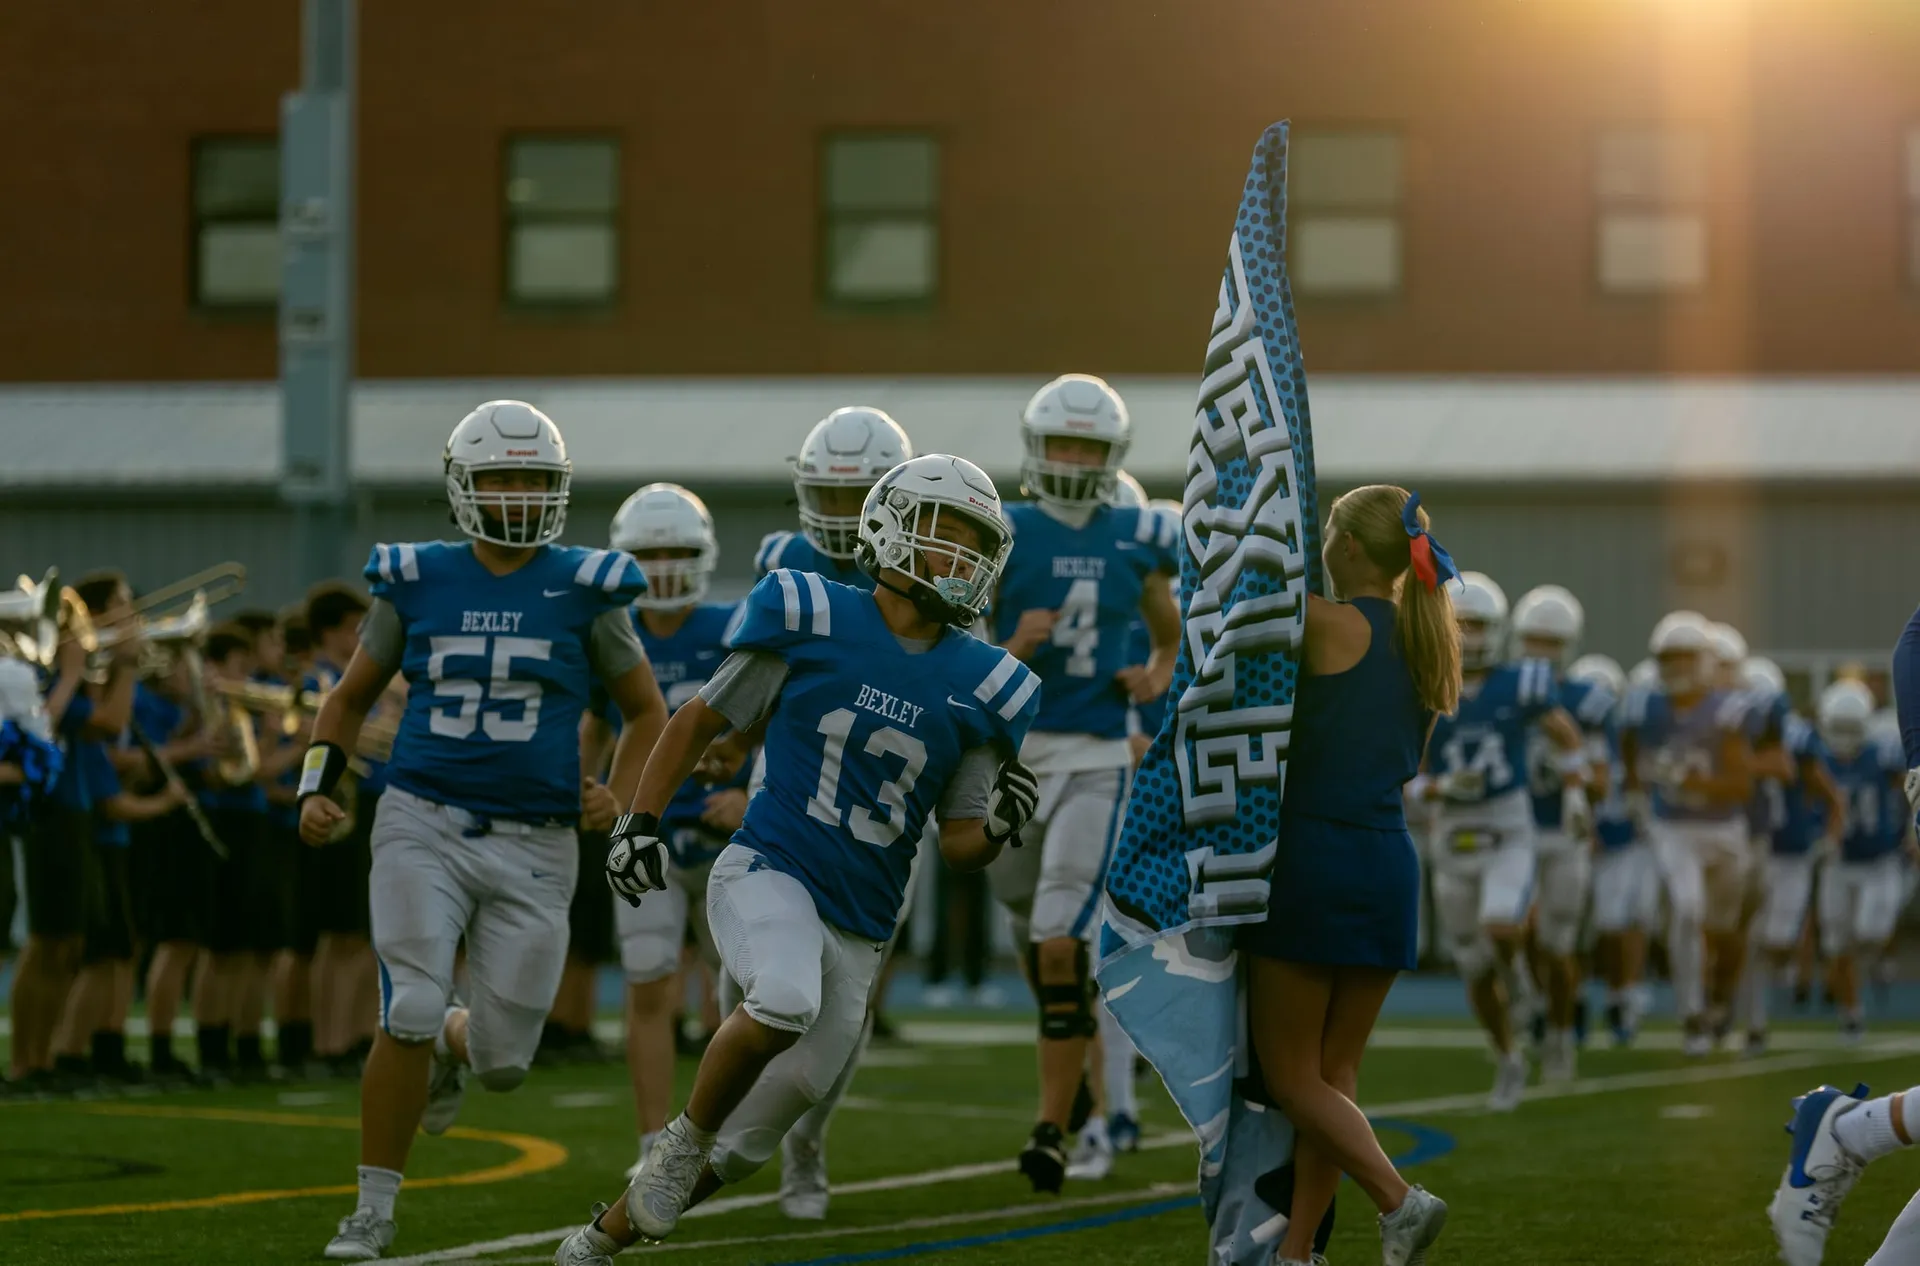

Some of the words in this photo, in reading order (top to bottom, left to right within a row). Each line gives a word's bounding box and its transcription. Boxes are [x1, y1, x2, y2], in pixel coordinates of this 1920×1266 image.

[1052, 556, 1106, 579] BEXLEY
[461, 610, 523, 633] BEXLEY
[1052, 579, 1099, 677] 4
[428, 635, 552, 742] 55
[854, 684, 924, 728] BEXLEY
[806, 707, 928, 848] 13
